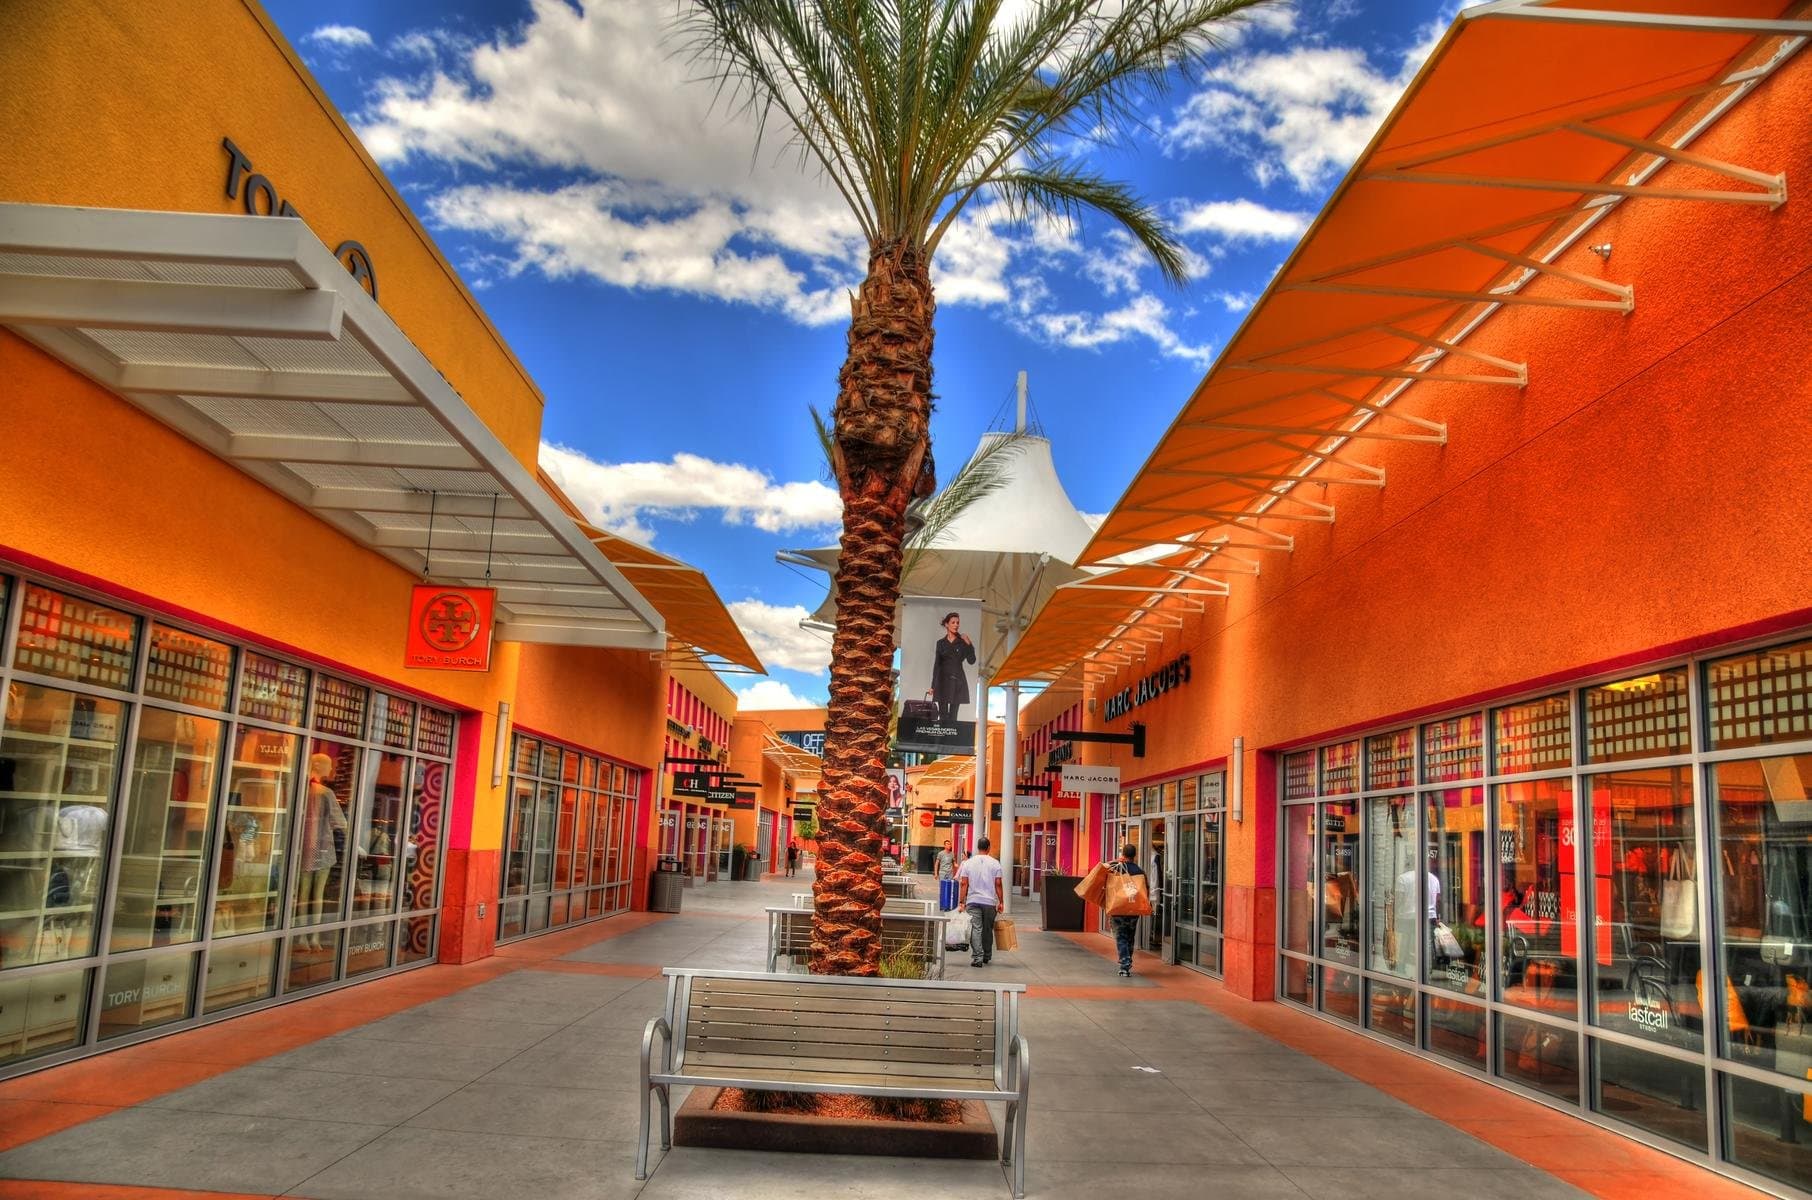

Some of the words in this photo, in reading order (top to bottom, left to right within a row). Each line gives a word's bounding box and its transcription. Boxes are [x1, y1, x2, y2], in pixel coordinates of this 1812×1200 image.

[411, 655, 439, 663] TORY
[443, 656, 482, 665] BURCH
[1104, 687, 1132, 723] MARC
[1134, 651, 1191, 706] JACOBS
[803, 733, 825, 747] OFF
[803, 746, 824, 760] TH
[683, 779, 698, 789] CH
[707, 791, 735, 799] CITIZEN
[108, 987, 140, 1007] TORY
[142, 983, 182, 1000] BURCH
[1628, 1002, 1668, 1030] lastcall
